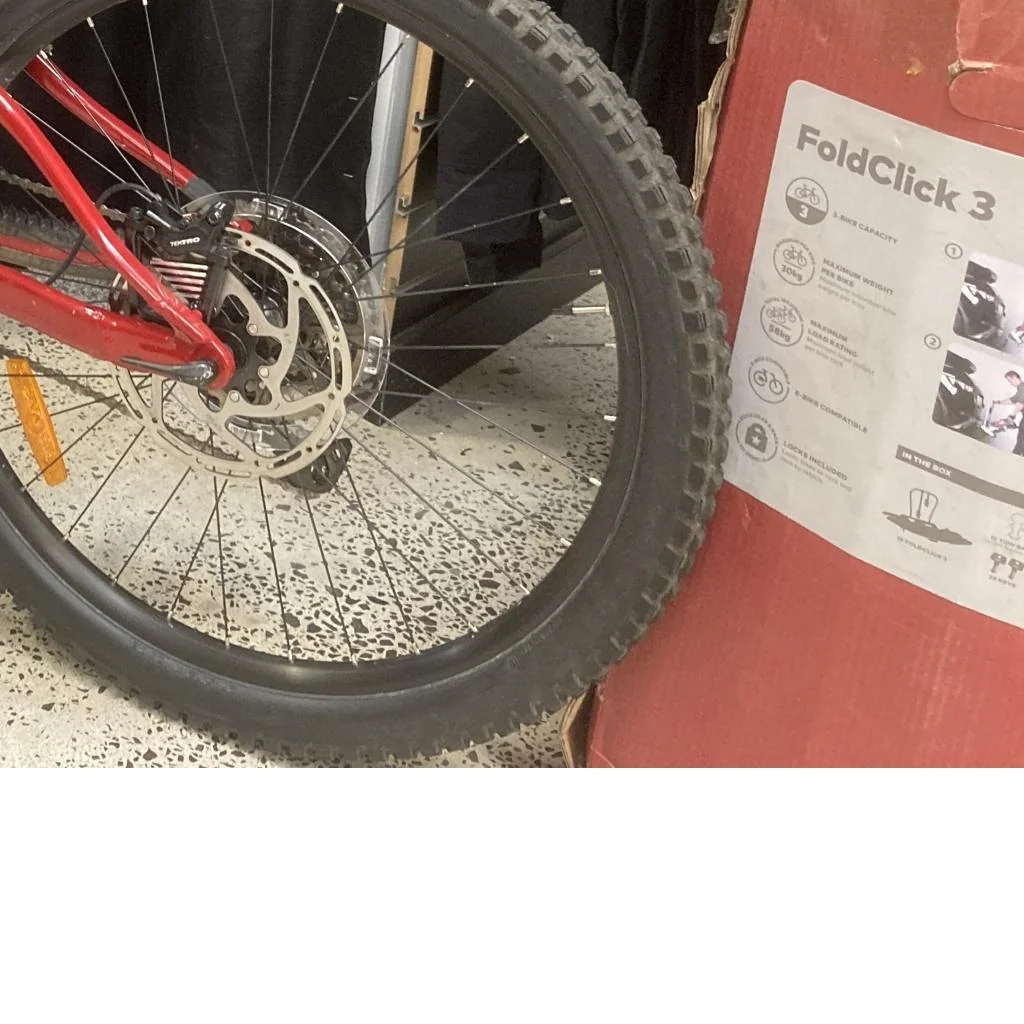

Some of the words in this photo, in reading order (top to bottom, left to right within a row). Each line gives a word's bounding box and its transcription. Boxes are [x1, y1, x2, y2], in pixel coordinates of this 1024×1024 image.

[796, 124, 961, 213] FoldClick
[968, 190, 997, 221] 3
[799, 204, 809, 218] 3
[858, 220, 898, 245] CAPACITY
[781, 264, 803, 282] 30kg
[821, 267, 836, 279] PER
[838, 274, 854, 288] BIKE
[823, 257, 861, 280] MAXIMUM
[863, 277, 894, 296] WEIGHT
[808, 329, 828, 343] LOAD
[830, 339, 858, 358] RATING
[810, 319, 848, 342] MAXIMUM
[820, 403, 868, 434] COMPATIBLE
[784, 440, 808, 459] LOCKS
[809, 454, 848, 481] INCLUDED
[902, 451, 913, 461] IN
[914, 456, 931, 469] THE
[932, 462, 952, 478] BOX
